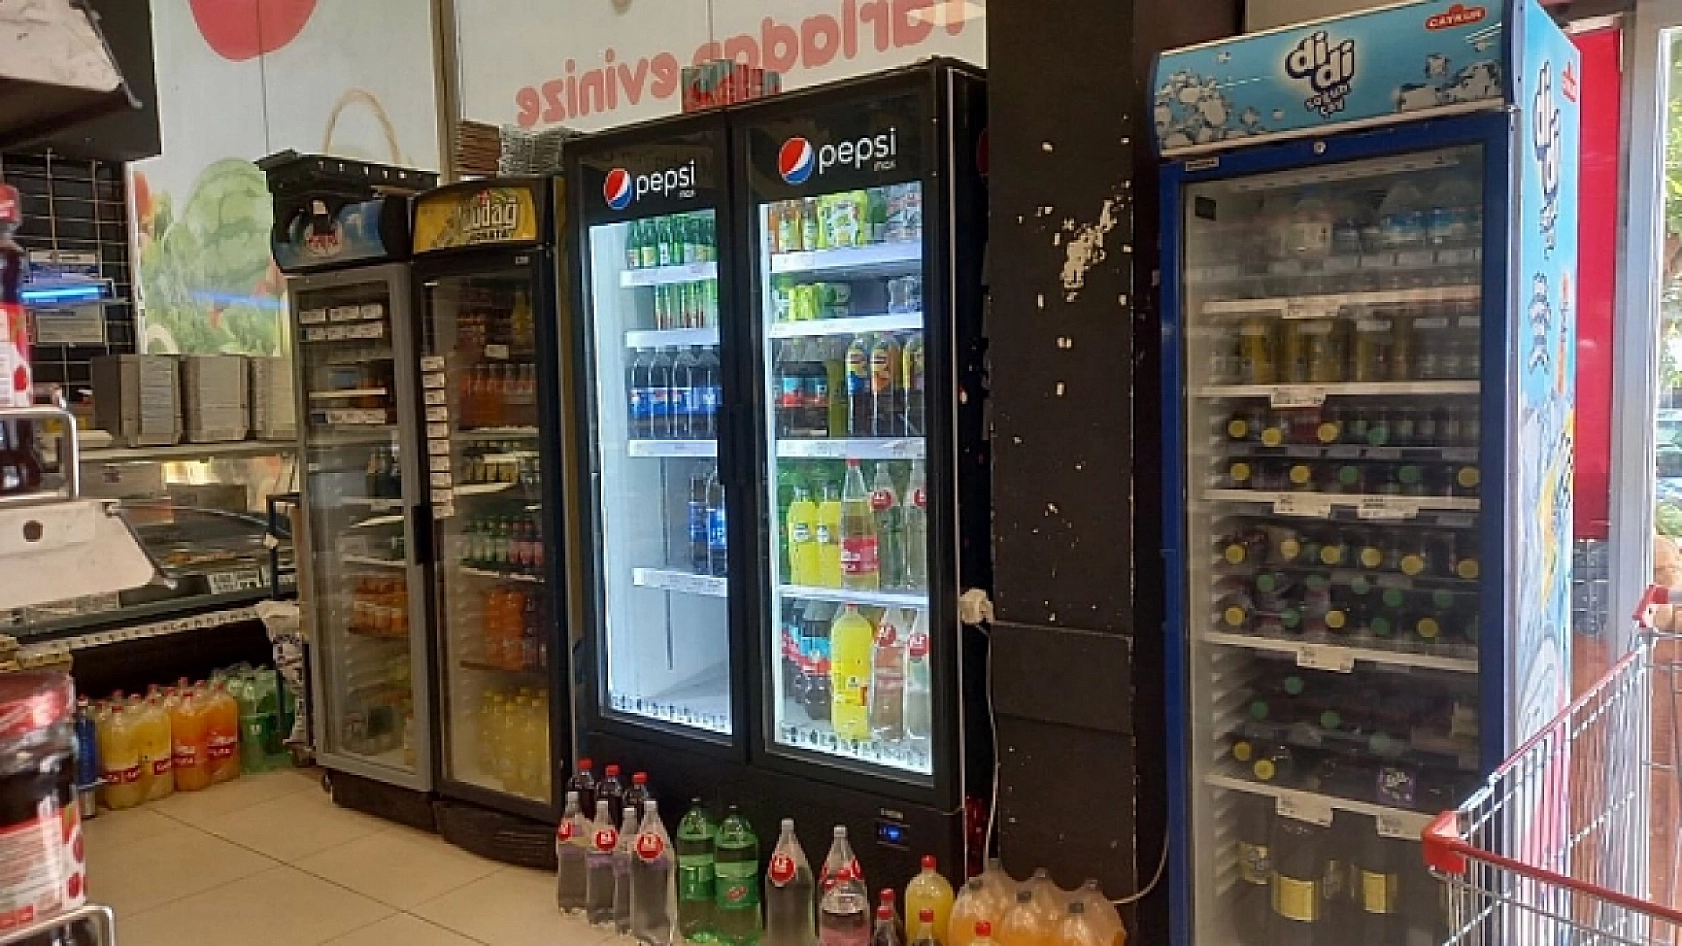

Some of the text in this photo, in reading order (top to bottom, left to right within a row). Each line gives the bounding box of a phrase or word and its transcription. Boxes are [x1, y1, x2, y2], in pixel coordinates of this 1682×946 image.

[1286, 32, 1328, 77] di
[1312, 40, 1354, 91] di
[818, 127, 897, 174] pepsi
[635, 159, 696, 196] pepsi
